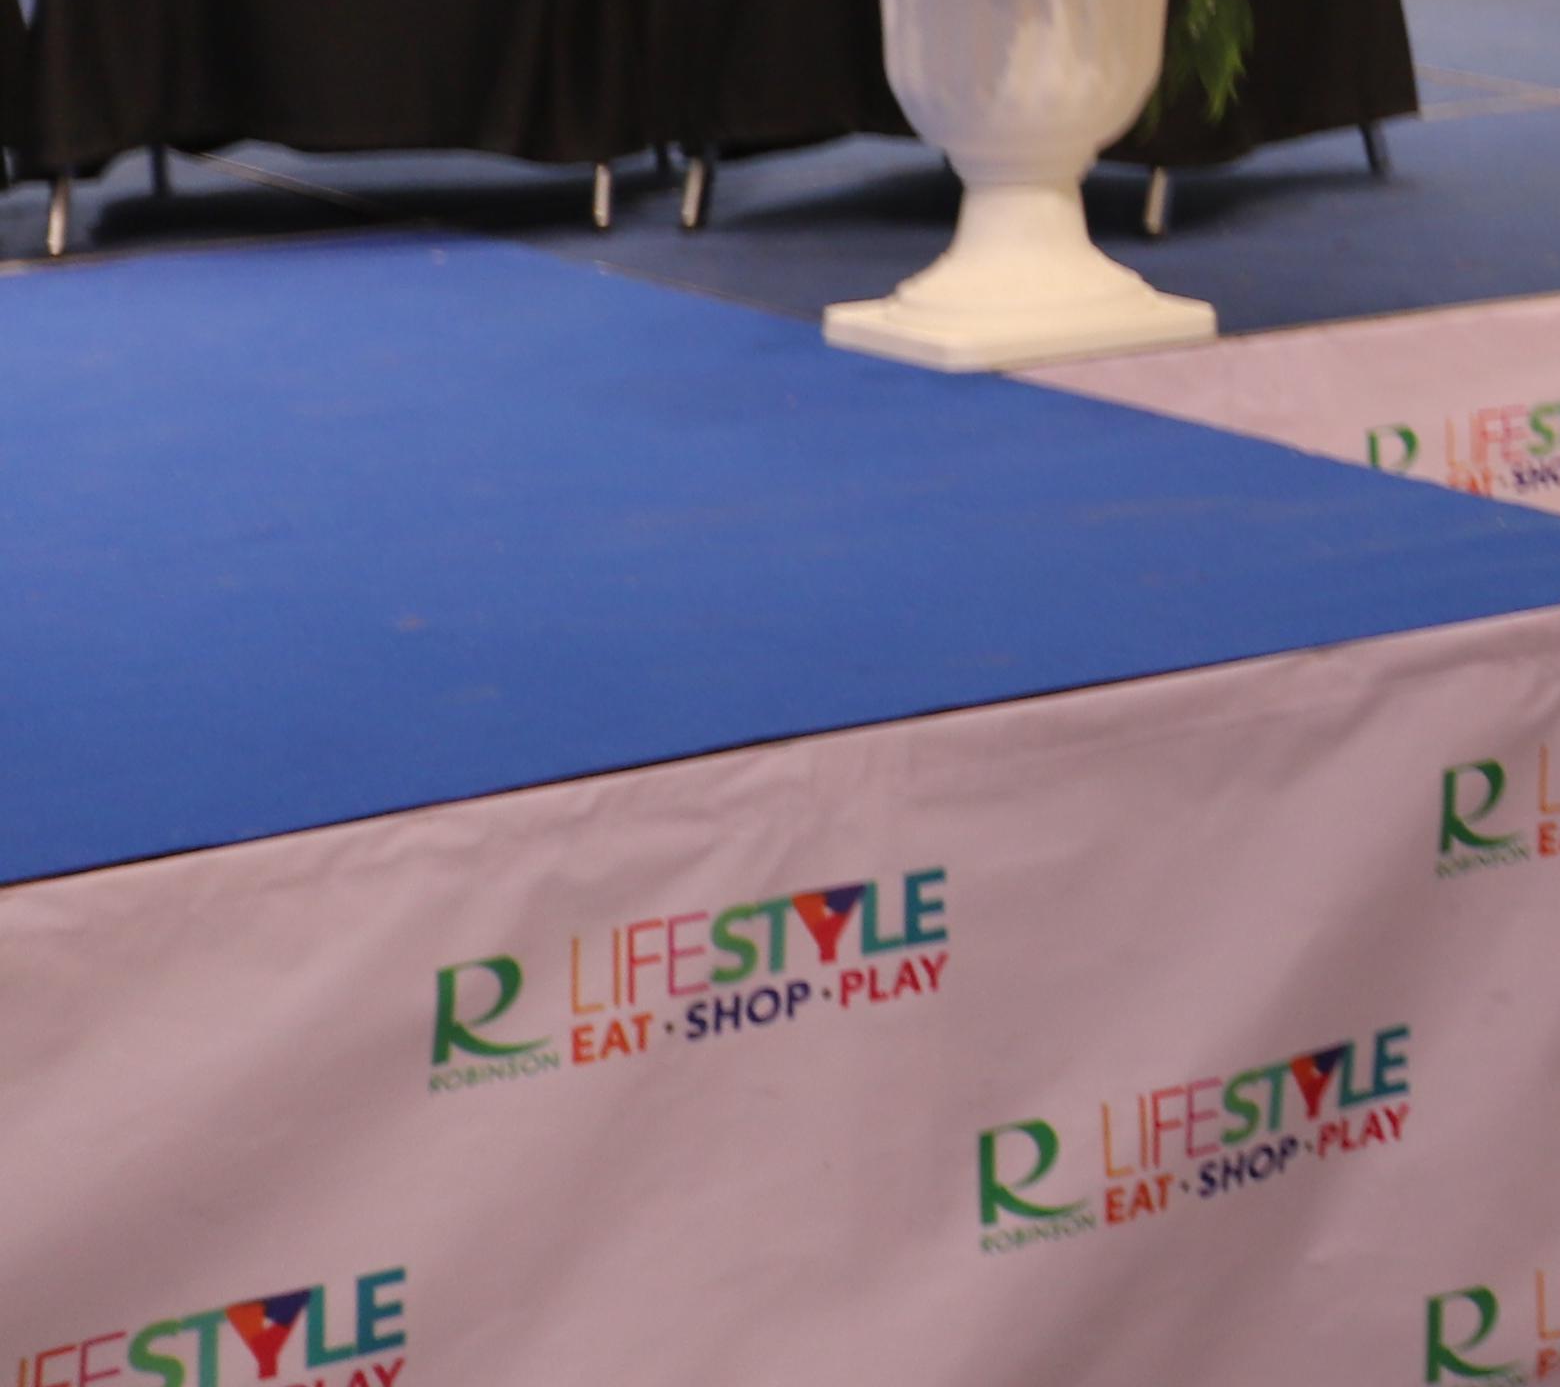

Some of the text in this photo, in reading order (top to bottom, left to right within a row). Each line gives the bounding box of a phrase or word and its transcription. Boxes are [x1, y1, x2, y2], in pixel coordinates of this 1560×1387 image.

[1440, 758, 1520, 853] R
[431, 867, 949, 1065] R LIFESTYLE
[571, 952, 949, 1065] EAT SHOP PLAY
[978, 1023, 1411, 1225] R LIFESTYLE
[1104, 1103, 1410, 1227] EAT SHOP PLAY
[1425, 1284, 1522, 1384] R
